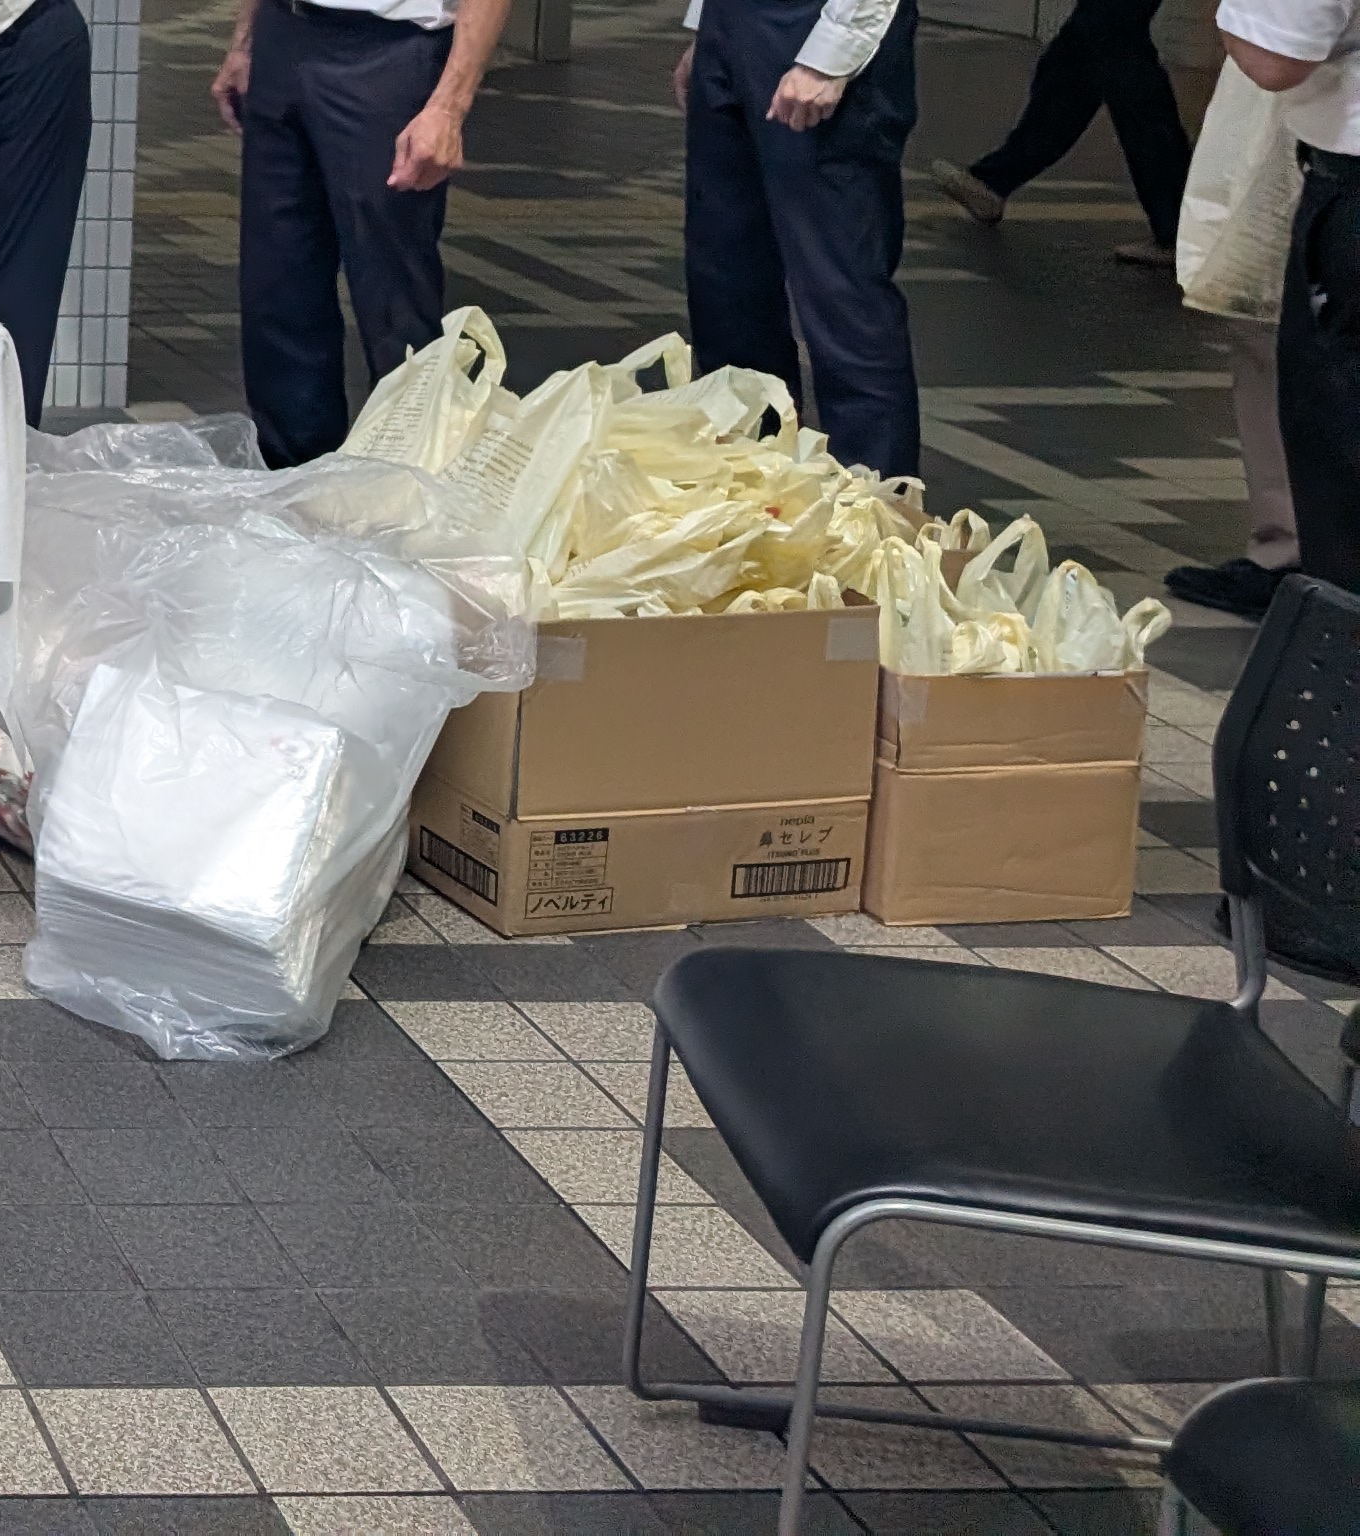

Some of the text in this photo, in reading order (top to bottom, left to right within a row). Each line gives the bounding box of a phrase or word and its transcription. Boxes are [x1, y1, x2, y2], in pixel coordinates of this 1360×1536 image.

[530, 894, 608, 914] ノベルティ
